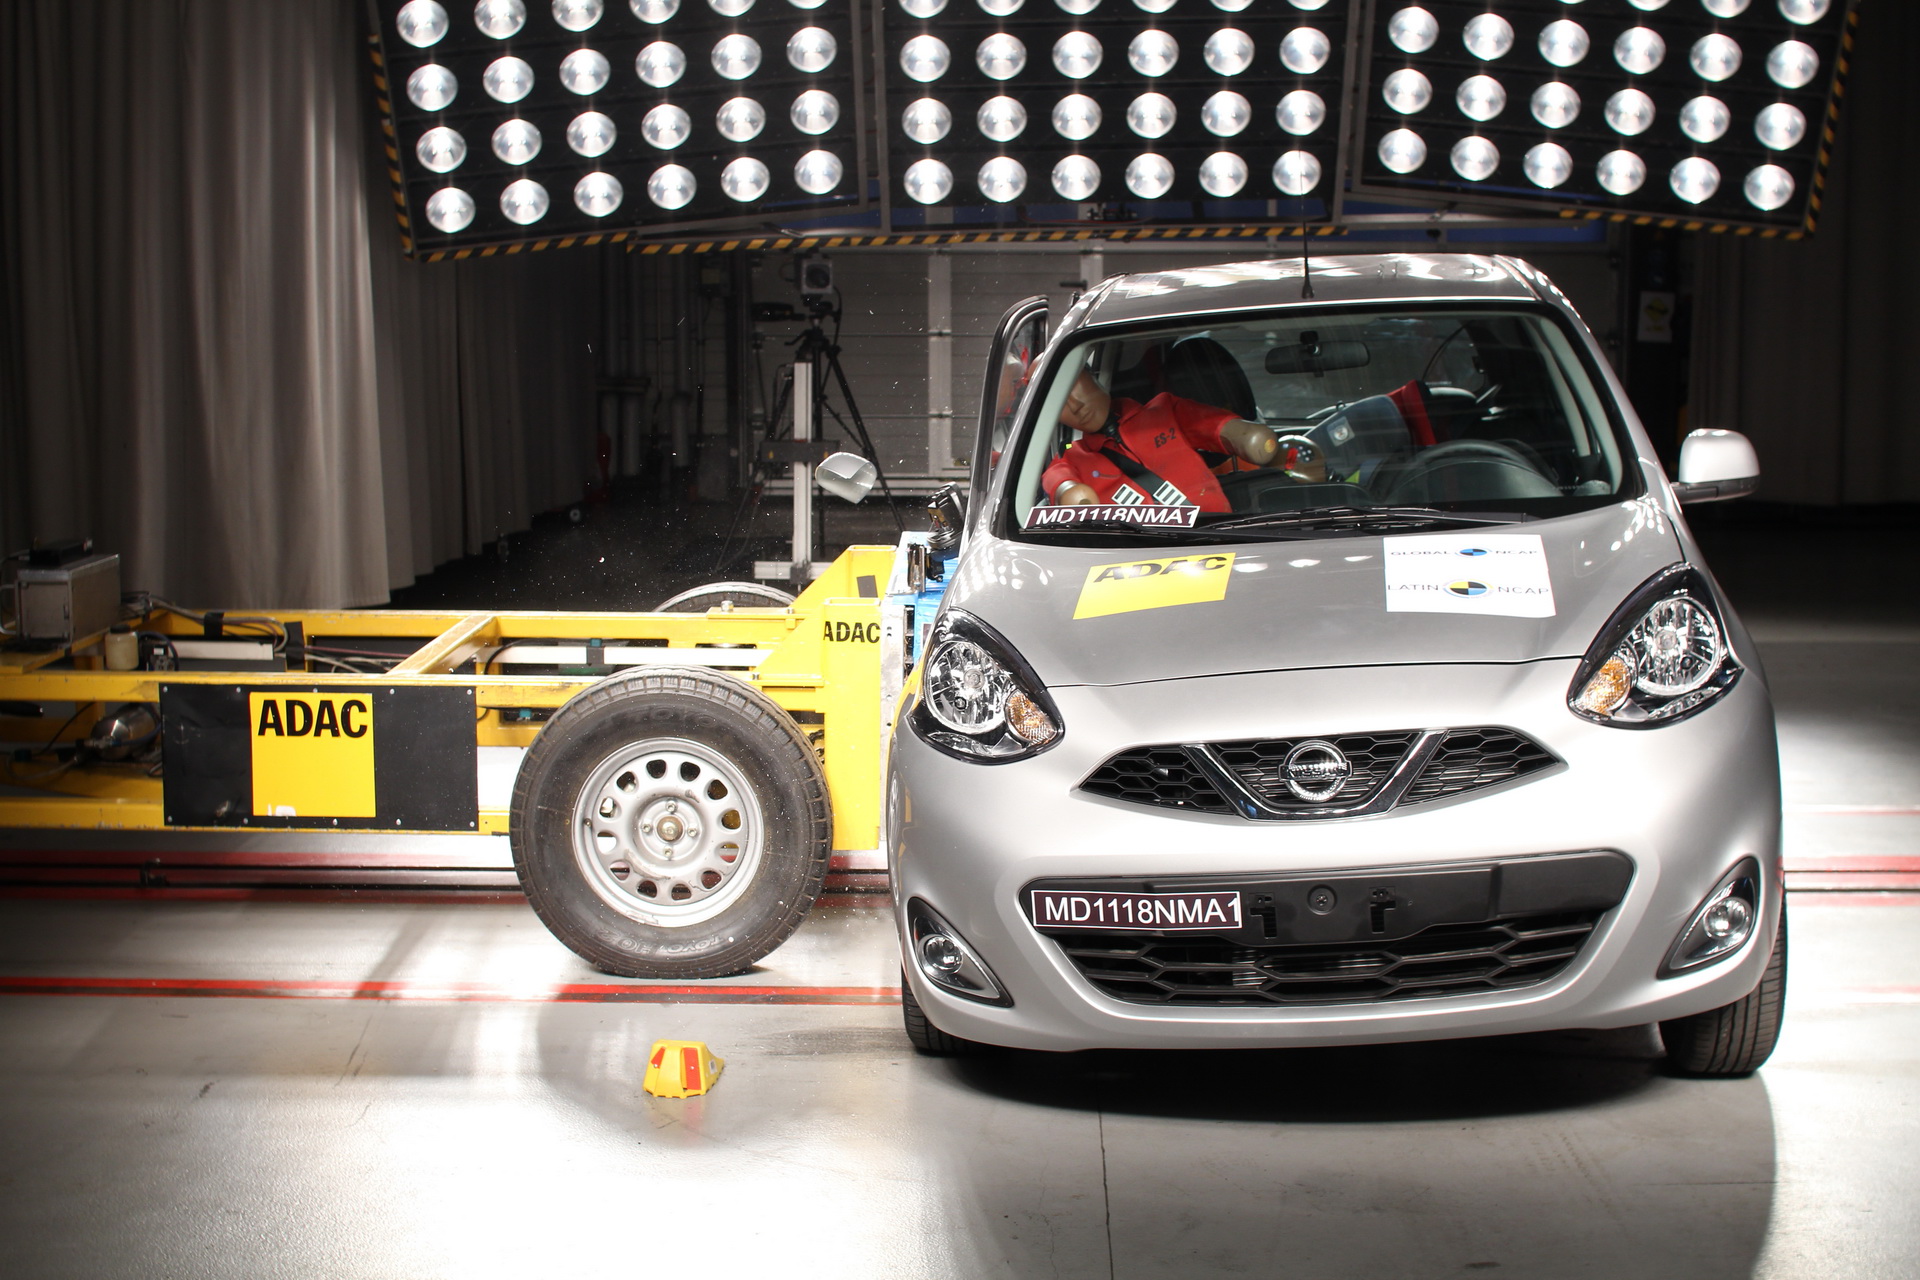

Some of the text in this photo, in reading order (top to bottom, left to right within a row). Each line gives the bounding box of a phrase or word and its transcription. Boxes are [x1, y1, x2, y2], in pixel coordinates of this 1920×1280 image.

[1154, 427, 1177, 448] ES-2
[1035, 507, 1196, 526] MD1118NMA1
[1093, 556, 1228, 583] ADAC
[1497, 586, 1549, 595] NCAP
[822, 620, 881, 644] ADAC
[257, 698, 369, 739] ADAC
[1045, 896, 1240, 924] MD1118NMA1
